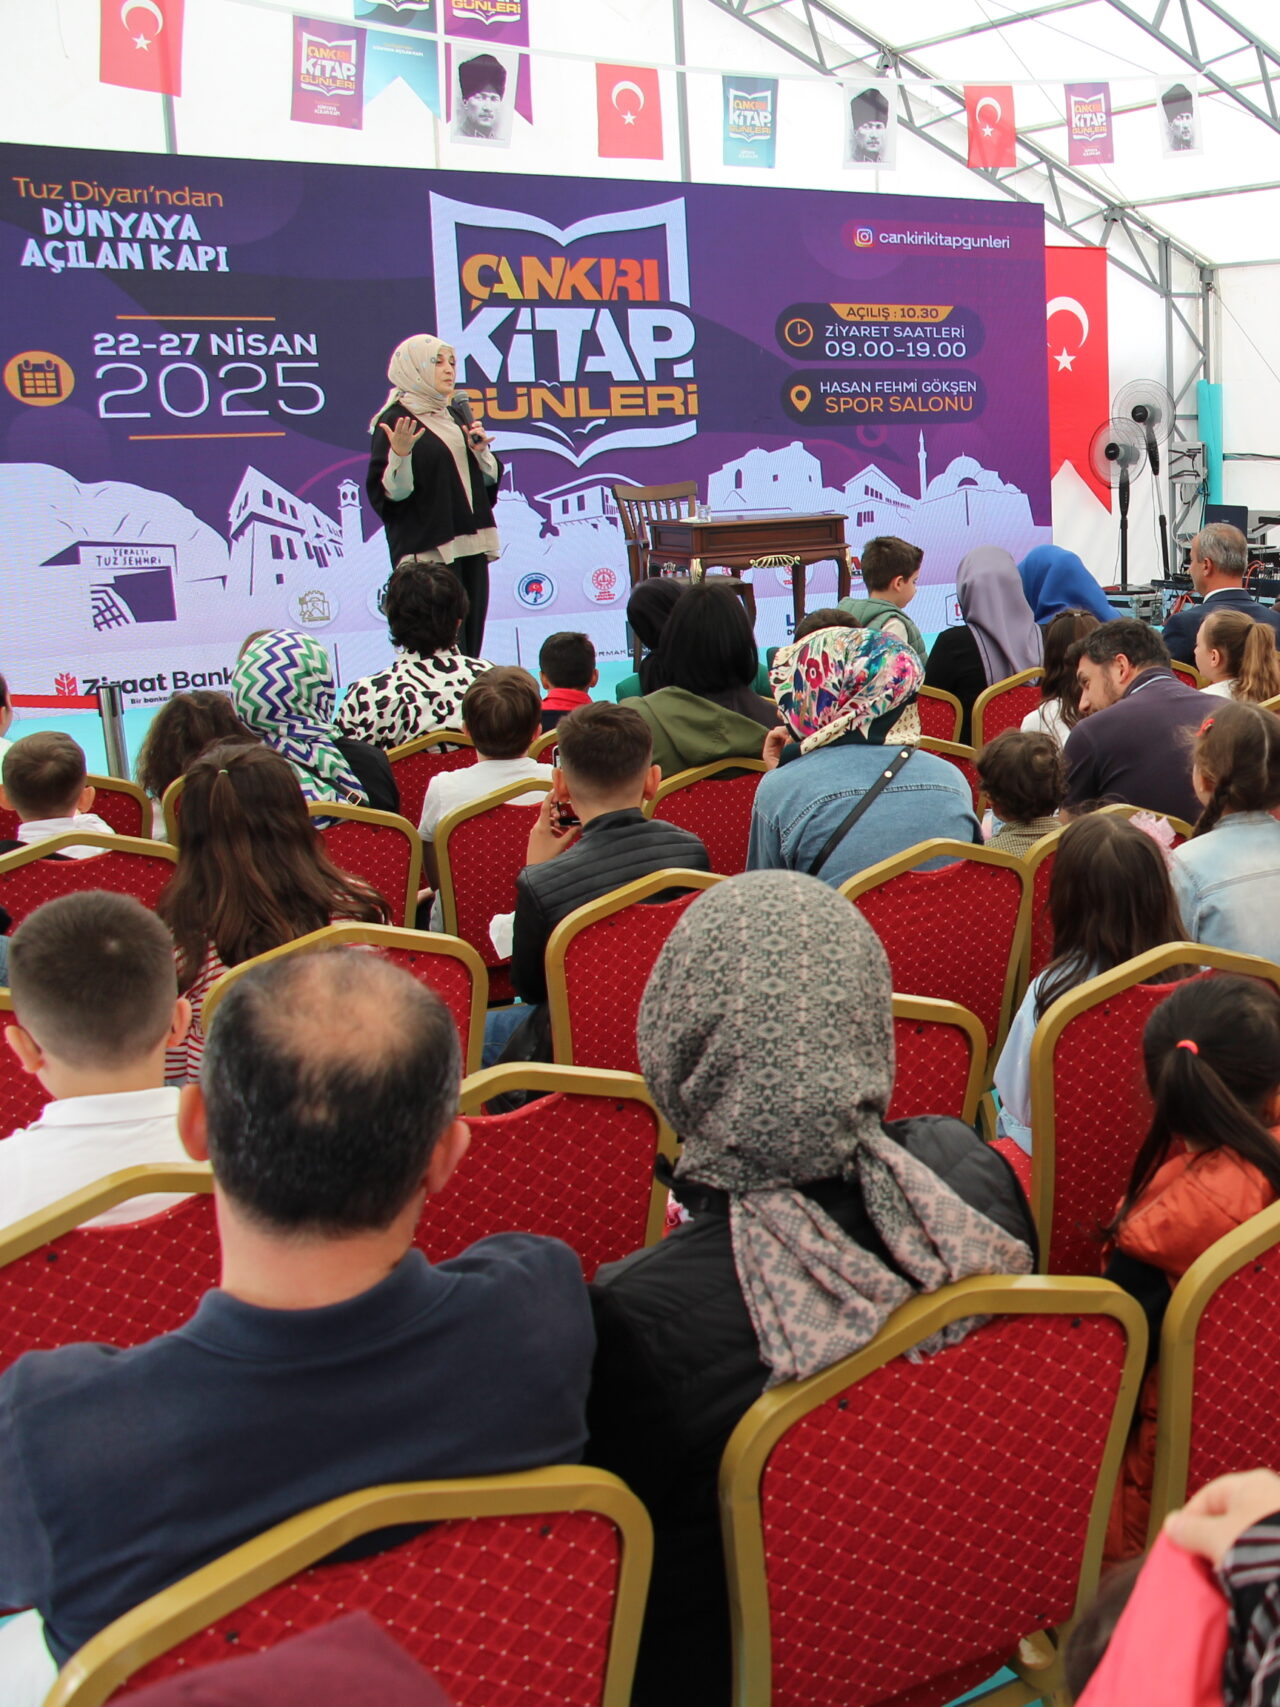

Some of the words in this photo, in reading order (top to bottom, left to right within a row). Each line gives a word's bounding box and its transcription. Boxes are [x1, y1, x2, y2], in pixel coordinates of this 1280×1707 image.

[12, 177, 63, 200] Tuz
[41, 202, 202, 241] DÜNYAYA
[879, 231, 1010, 250] cankirikitapgunleri
[20, 238, 145, 274] AÇILAN
[150, 244, 230, 272] KAPI
[462, 253, 661, 311] ÇANKIRI
[846, 307, 890, 320] AÇILIŞ
[900, 308, 939, 319] 10.30
[825, 323, 889, 338] ZİYARET
[893, 325, 965, 338] SAATLERİ
[93, 333, 200, 356] 22-27
[210, 327, 318, 356] NİSAN
[438, 307, 696, 383] KİTAP
[825, 341, 967, 358] 09.00-19.00
[95, 362, 326, 419] 2025
[820, 382, 871, 394] HASAN
[875, 379, 917, 393] FEHMİ
[921, 379, 977, 395] GÖKŞEN
[825, 397, 883, 413] SPOR
[889, 396, 973, 412] SALONU
[96, 555, 118, 567] TUZ
